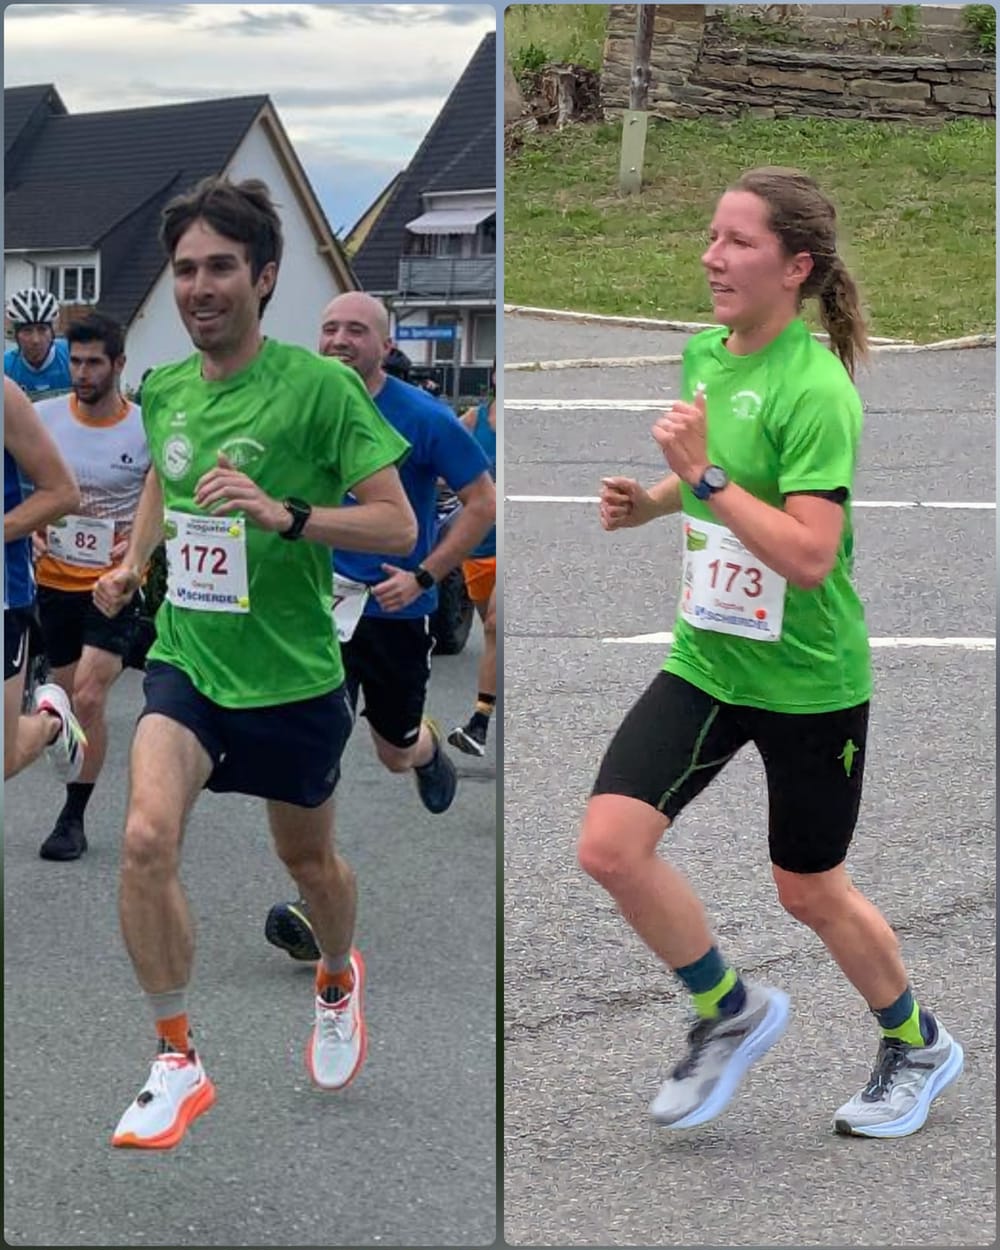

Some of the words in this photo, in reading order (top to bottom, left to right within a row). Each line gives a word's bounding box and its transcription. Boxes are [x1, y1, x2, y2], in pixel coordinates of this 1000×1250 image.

[75, 532, 97, 550] 82
[181, 544, 228, 575] 172
[709, 559, 763, 598] 173
